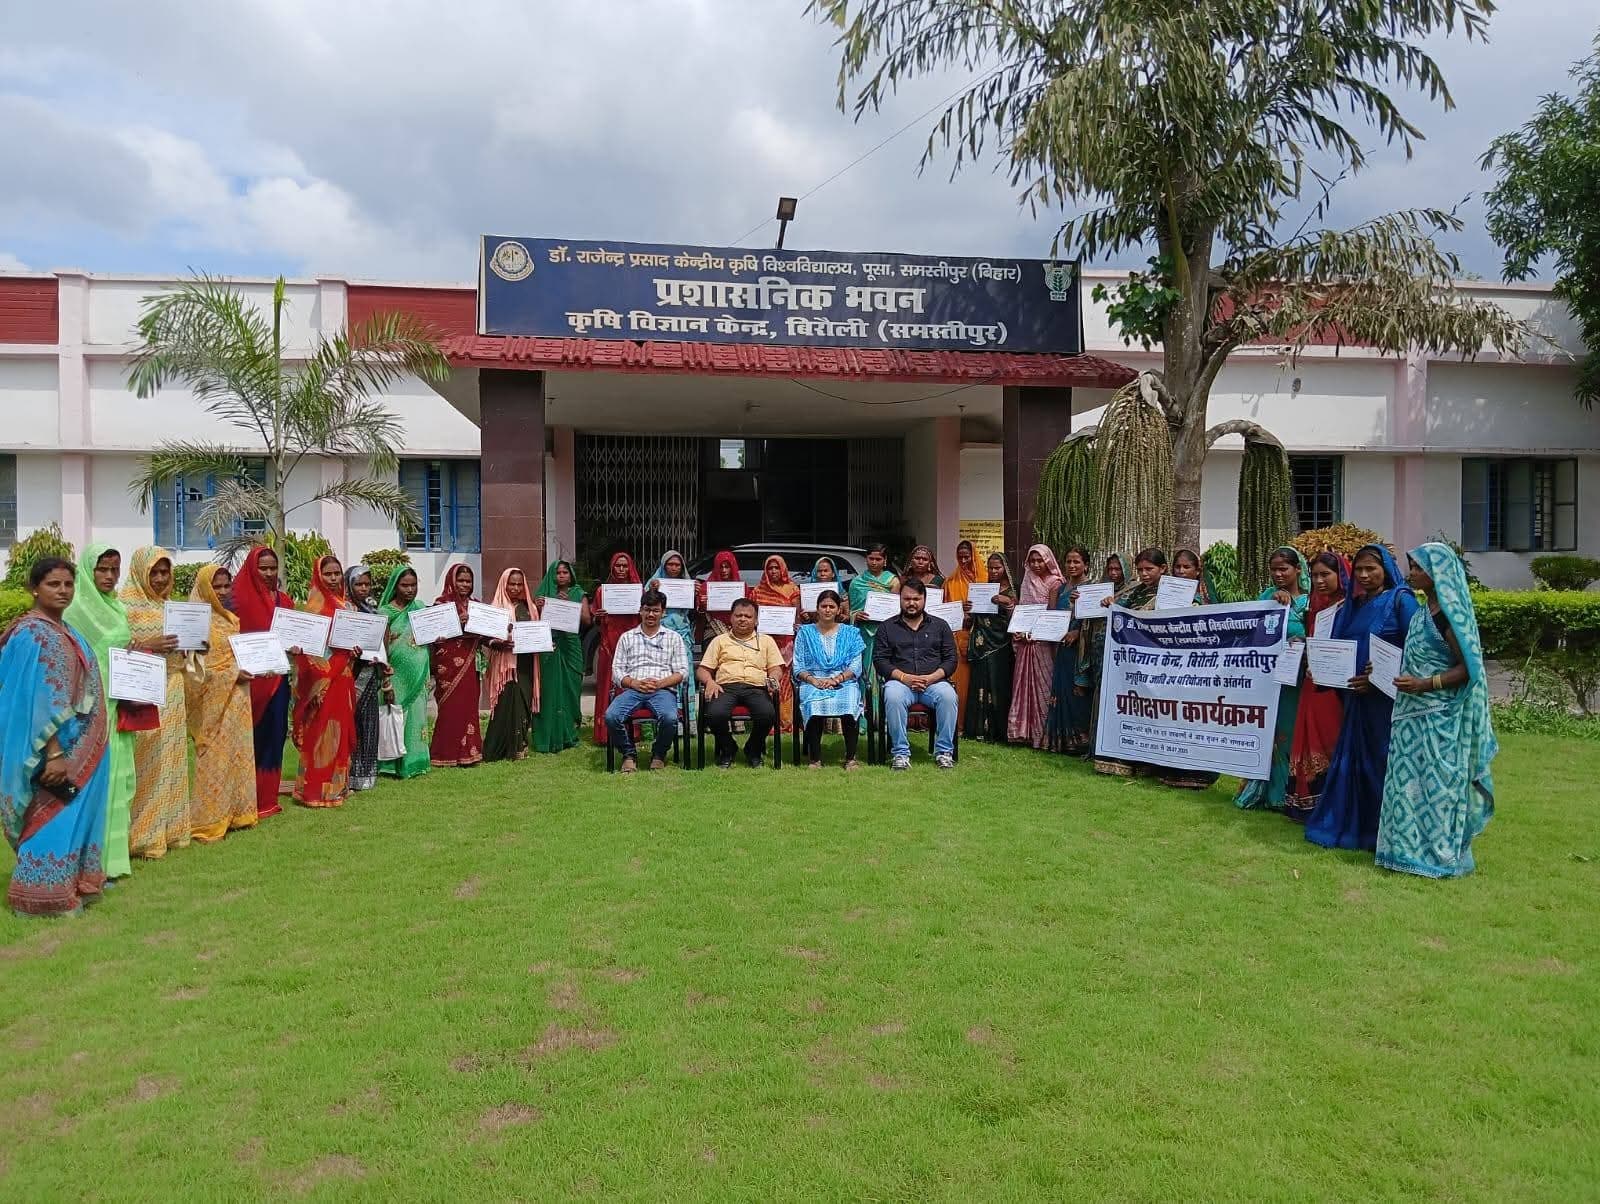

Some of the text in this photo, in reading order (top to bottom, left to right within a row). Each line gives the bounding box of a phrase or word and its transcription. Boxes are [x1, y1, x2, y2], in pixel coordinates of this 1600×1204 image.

[549, 246, 1022, 284] डॉ. राजेन्द्र प्रसाद केन्द्रीय कृषि विश्वविद्यालय, पूसा, समस्तीपुर (बिहार)
[652, 276, 926, 314] प्रशासनिक भवन
[565, 308, 1008, 345] कृषि विज्ञान केन्द्र, बिरौली (समस्तीपुर)
[1192, 619, 1207, 636] कृषि
[1113, 647, 1127, 667] कृषि
[1127, 648, 1160, 666] विज्ञान
[1161, 651, 1183, 670] केन्द्र,
[1223, 650, 1279, 674] समस्तीपुर
[1213, 674, 1221, 687] के
[1223, 674, 1253, 689] अंतर्गत
[1116, 690, 1268, 728] प्रशिक्षण कार्यक्रम
